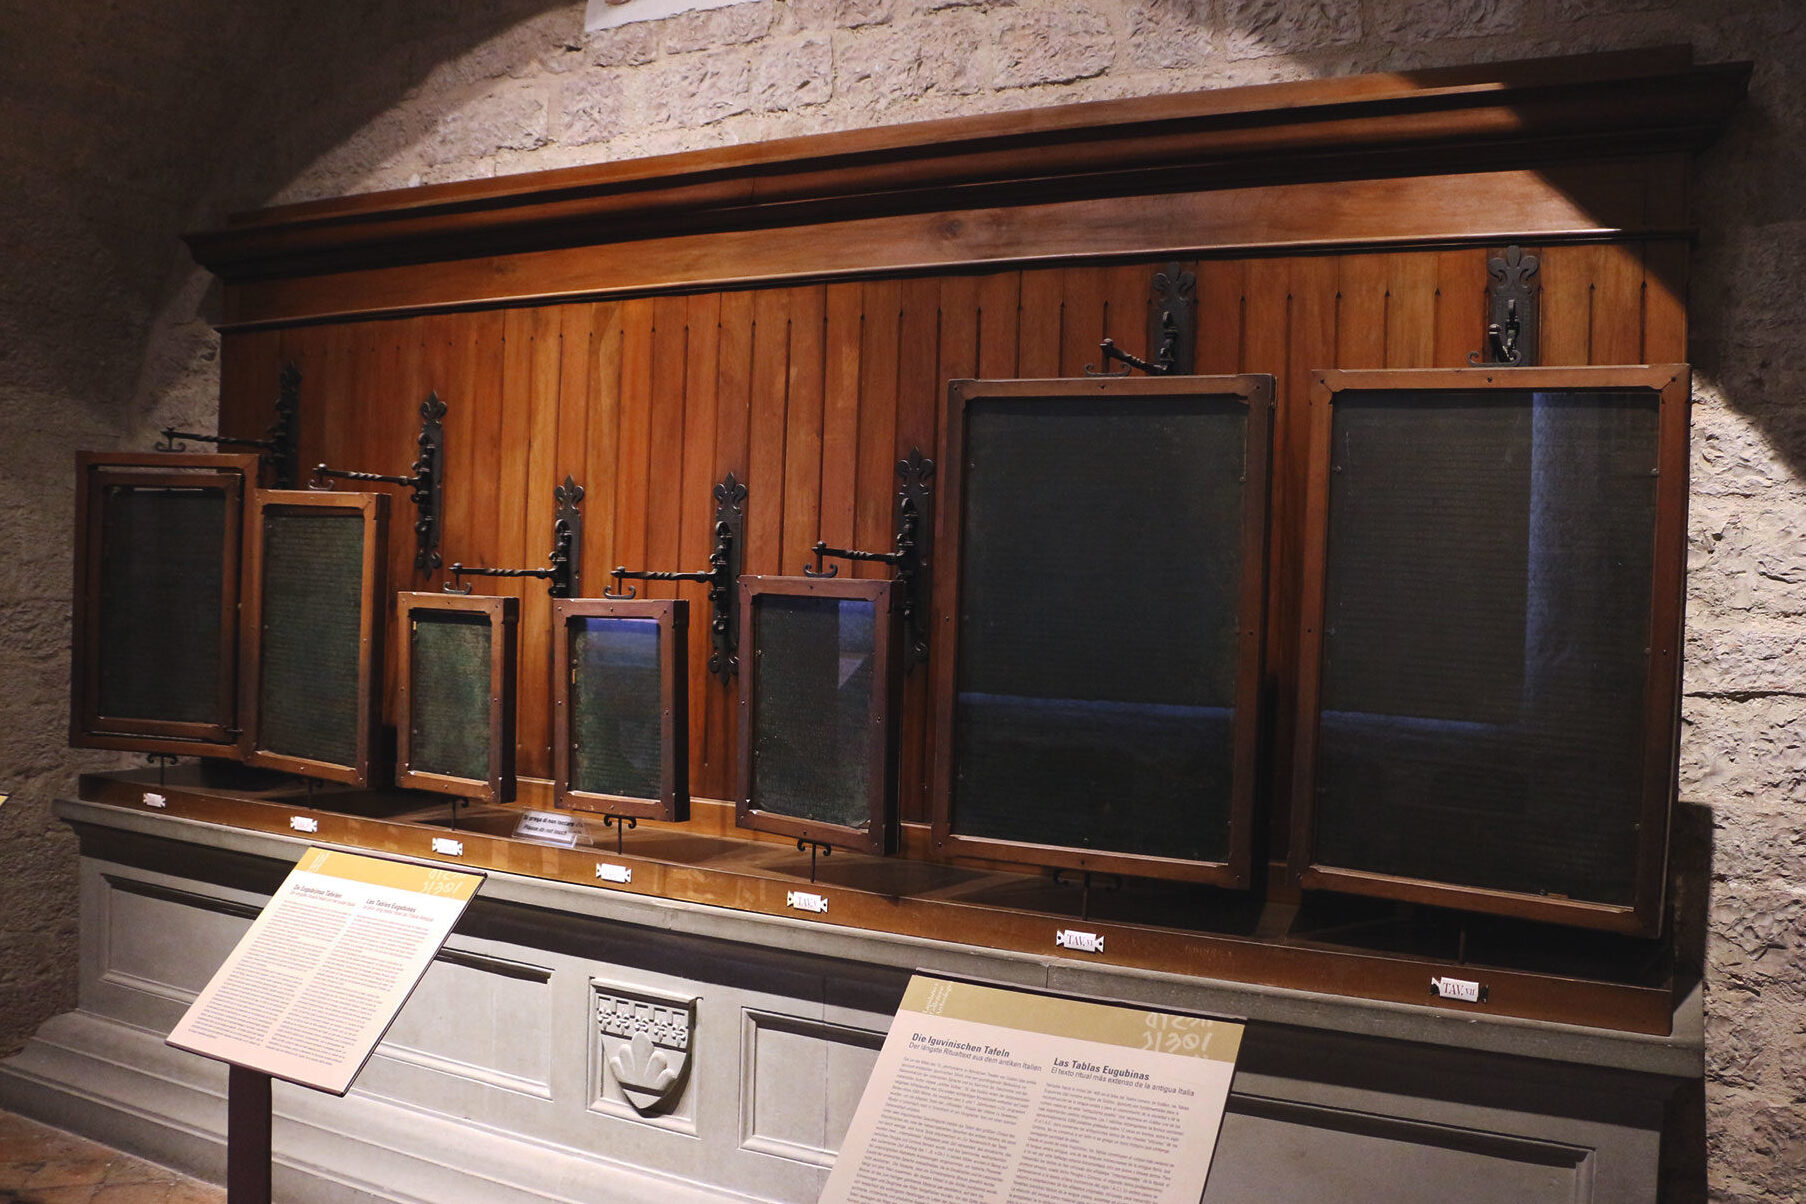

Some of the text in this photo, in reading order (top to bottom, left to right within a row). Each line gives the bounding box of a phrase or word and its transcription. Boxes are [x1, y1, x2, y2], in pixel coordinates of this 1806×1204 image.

[1443, 982, 1464, 996] TAV.
[908, 1042, 920, 1050] Der
[943, 1048, 972, 1059] Ritualtext
[984, 1055, 997, 1063] dem
[998, 1057, 1022, 1068] antiken
[1022, 1061, 1042, 1072] Italien
[911, 1032, 1010, 1058] Die Iguvinischen Tafeln
[1053, 1057, 1151, 1081] Las Tablas Eugubinas
[1057, 1068, 1075, 1077] texto
[1075, 1070, 1092, 1080] ritual
[1092, 1073, 1107, 1082] más
[1107, 1077, 1133, 1087] extenso
[1134, 1080, 1143, 1088] de
[1151, 1084, 1177, 1095] antigua
[1177, 1087, 1195, 1097] Italia
